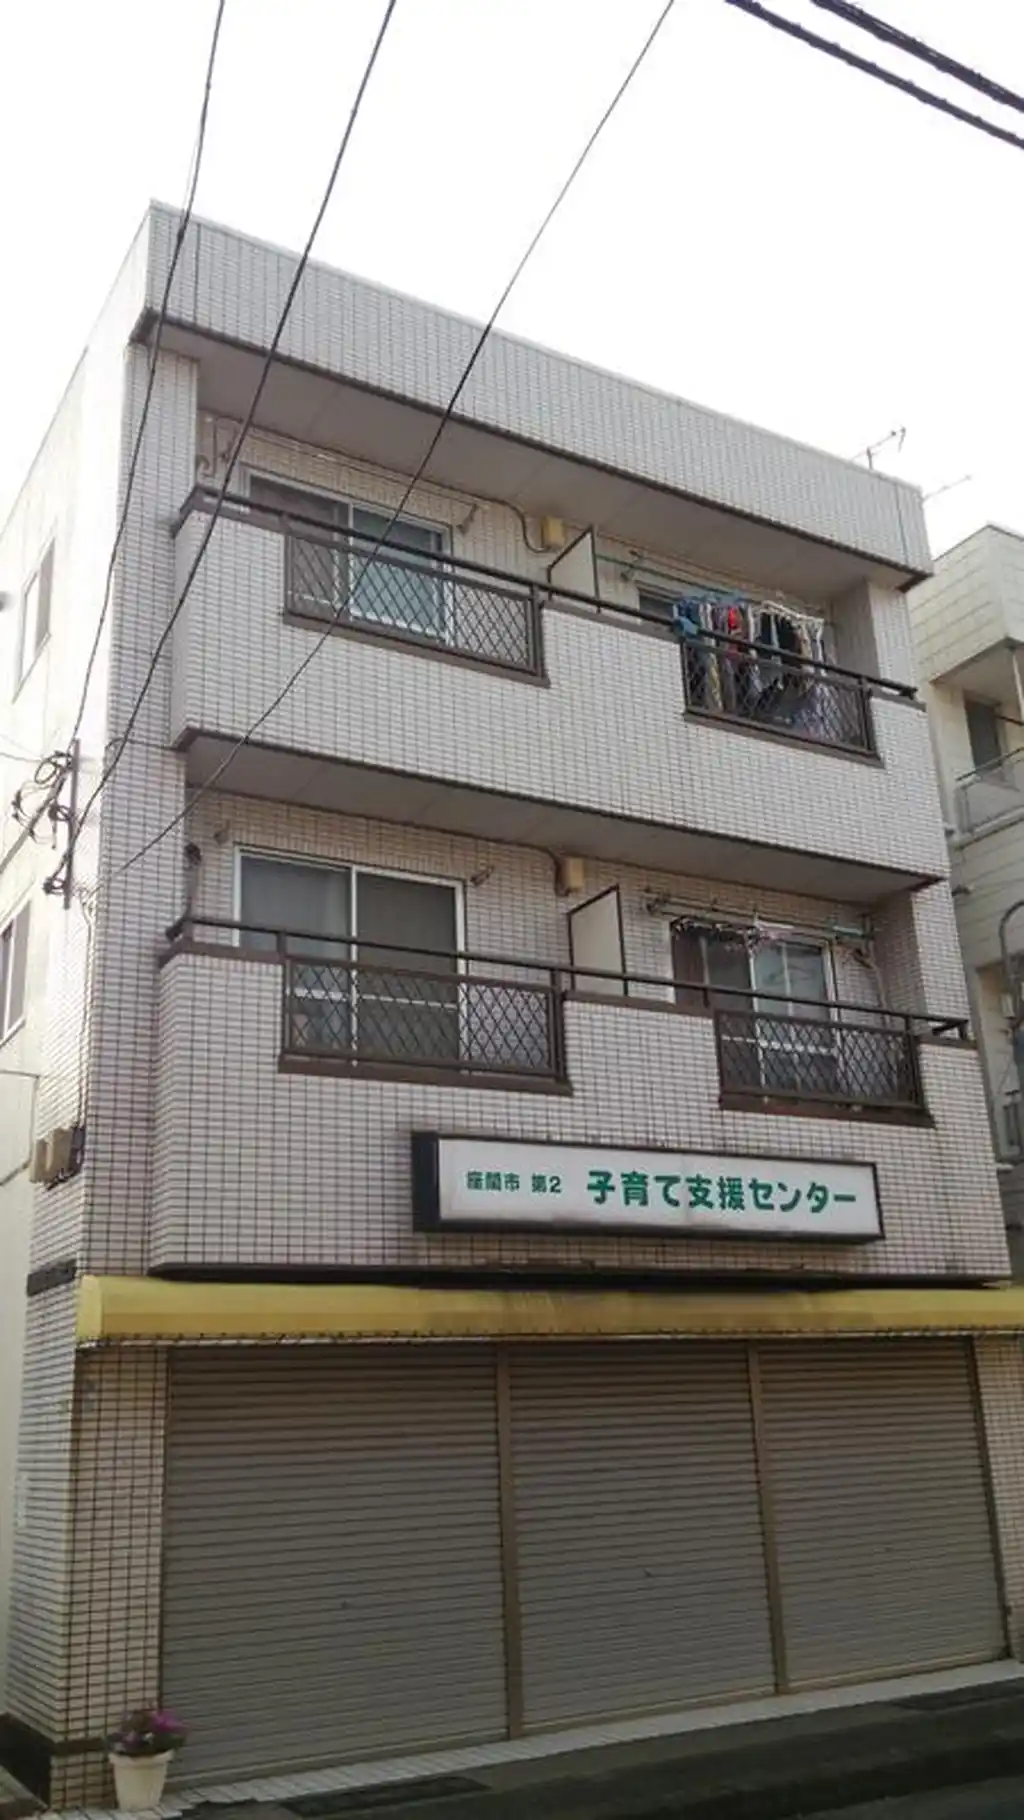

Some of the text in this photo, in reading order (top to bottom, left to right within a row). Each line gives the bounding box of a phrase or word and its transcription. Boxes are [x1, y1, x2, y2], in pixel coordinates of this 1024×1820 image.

[586, 1169, 857, 1213] 子育て支援センター
